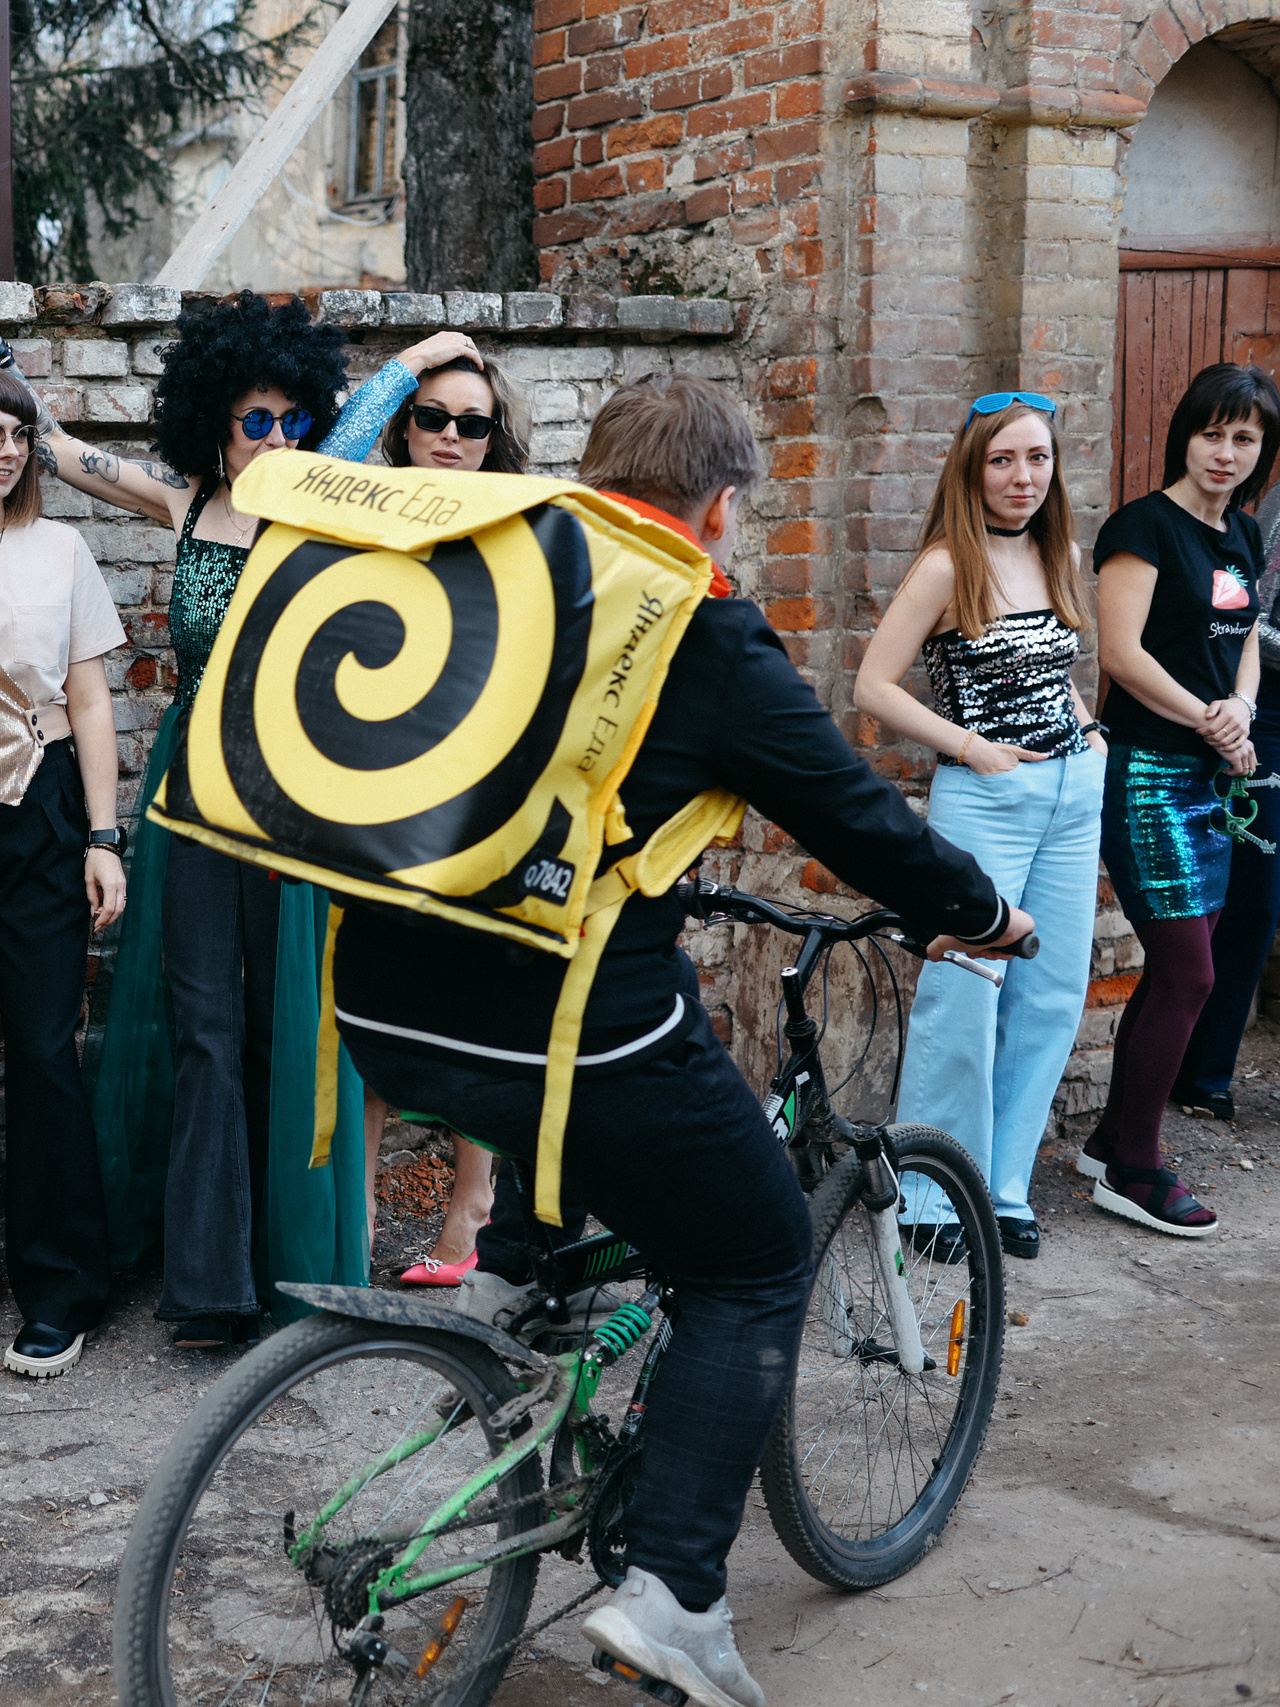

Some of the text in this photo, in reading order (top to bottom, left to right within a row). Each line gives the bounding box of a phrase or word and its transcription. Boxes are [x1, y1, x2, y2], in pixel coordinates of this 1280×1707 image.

[292, 465, 462, 527] Яндекс Еда
[577, 590, 664, 773] Яндекс Еда
